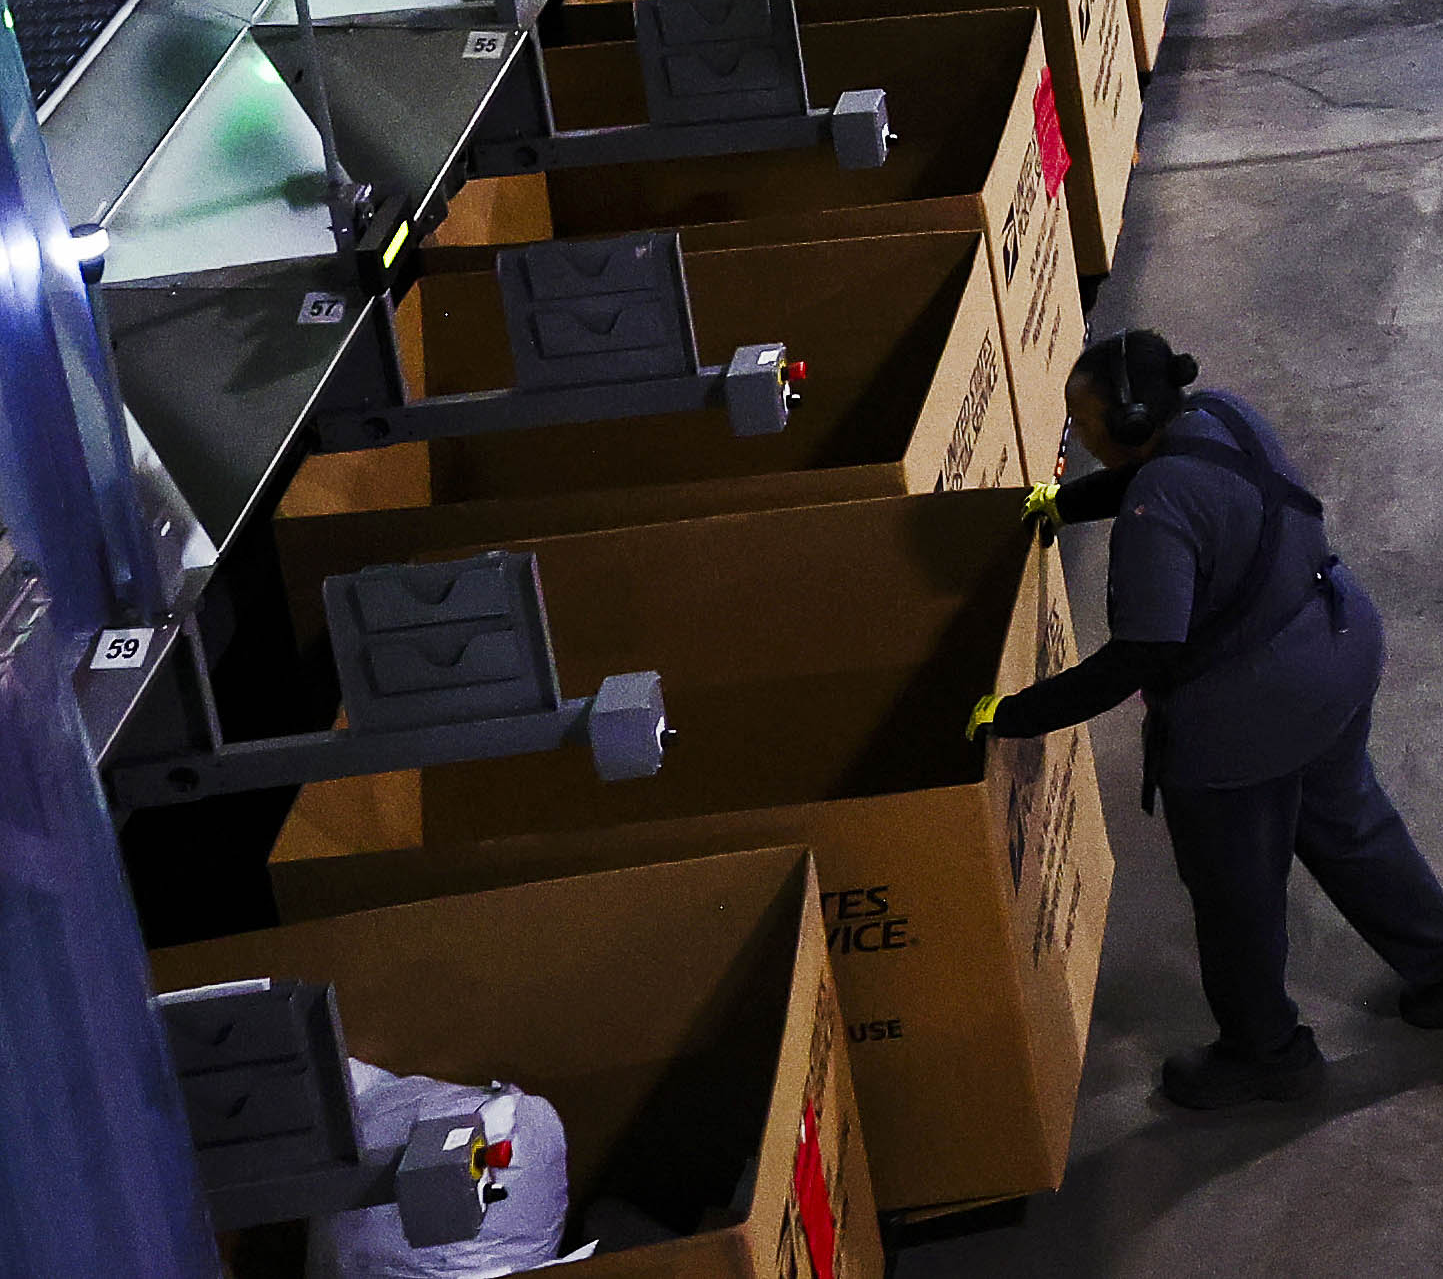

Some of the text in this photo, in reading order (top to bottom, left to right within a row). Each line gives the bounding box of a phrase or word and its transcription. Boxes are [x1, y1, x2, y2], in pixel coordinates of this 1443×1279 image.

[474, 38, 498, 53] 55
[310, 298, 336, 319] 57
[105, 637, 140, 661] 59
